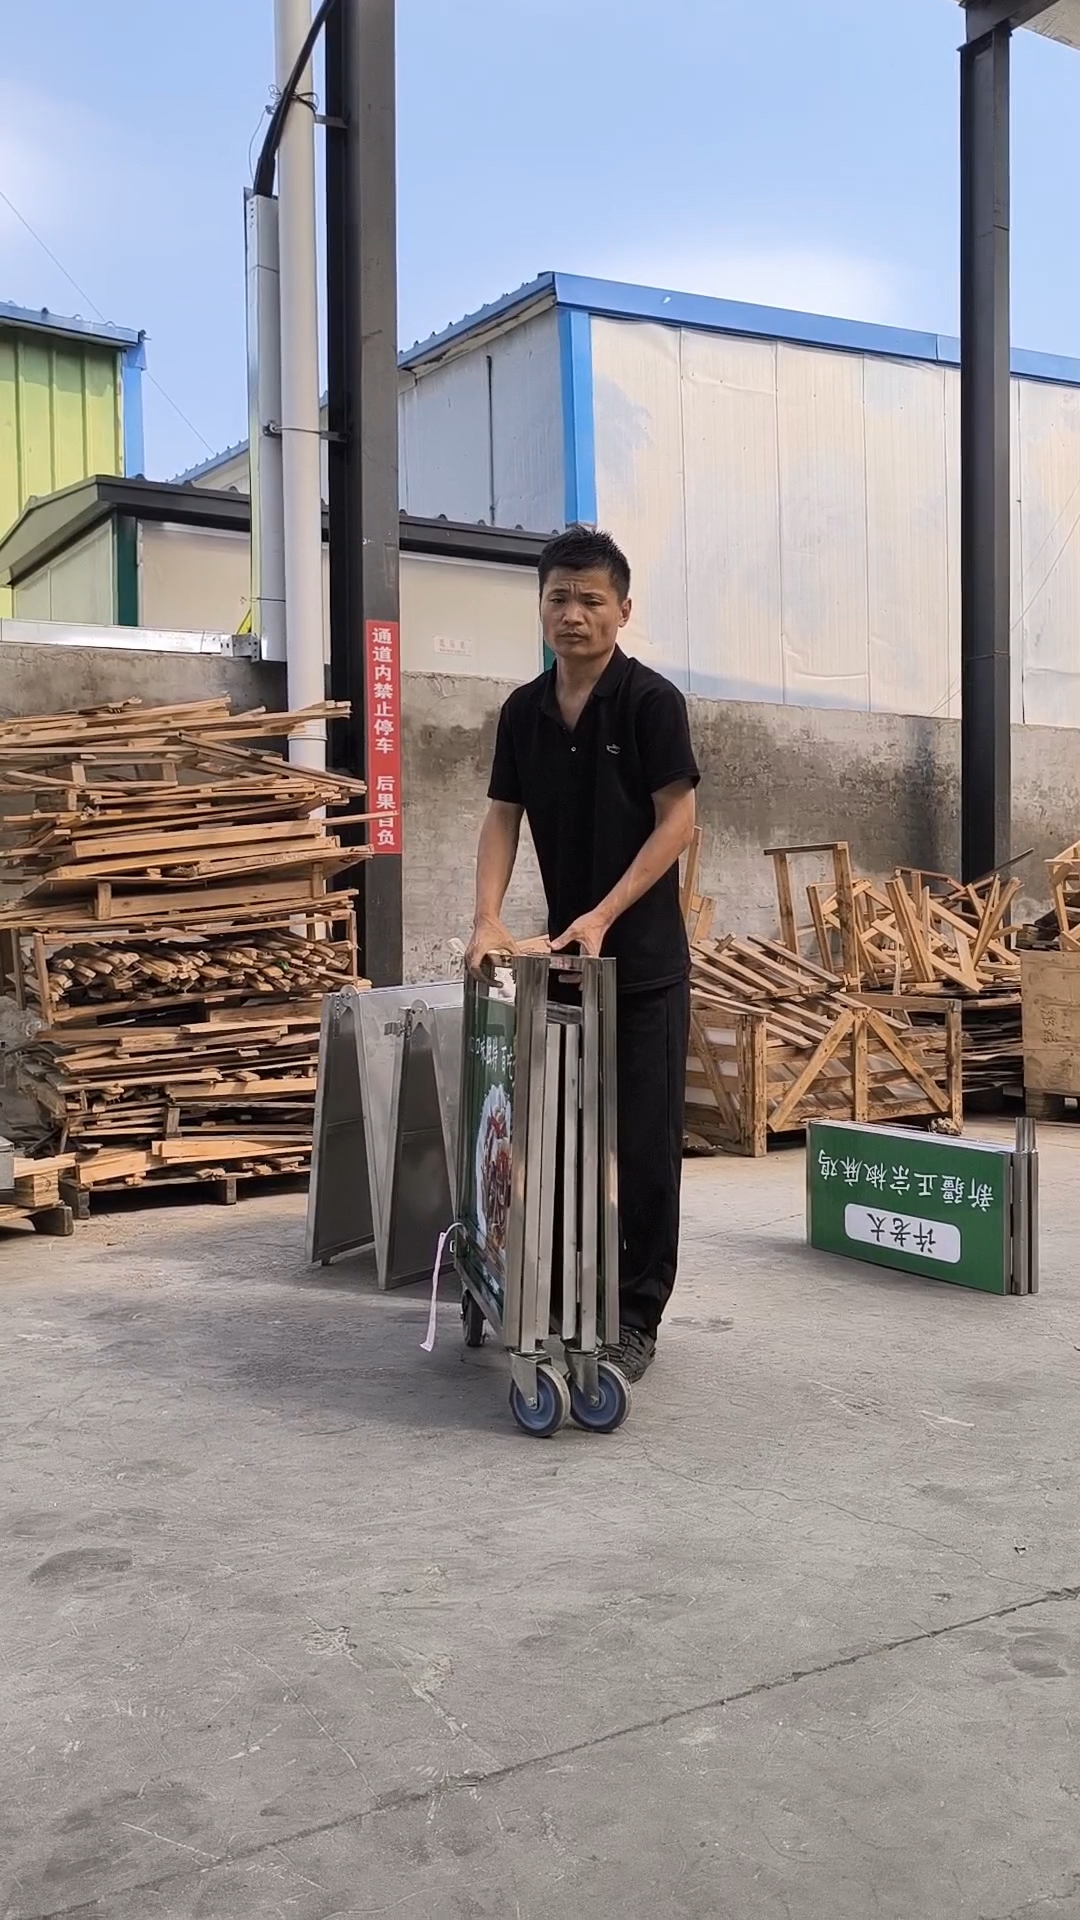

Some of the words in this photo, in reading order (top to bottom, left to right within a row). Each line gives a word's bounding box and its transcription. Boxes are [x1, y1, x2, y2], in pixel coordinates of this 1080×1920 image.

[371, 627, 395, 754] 通道内禁止停车
[818, 1149, 994, 1212] 新疆正宗椒麻鸡
[866, 1213, 937, 1254] 许老太
